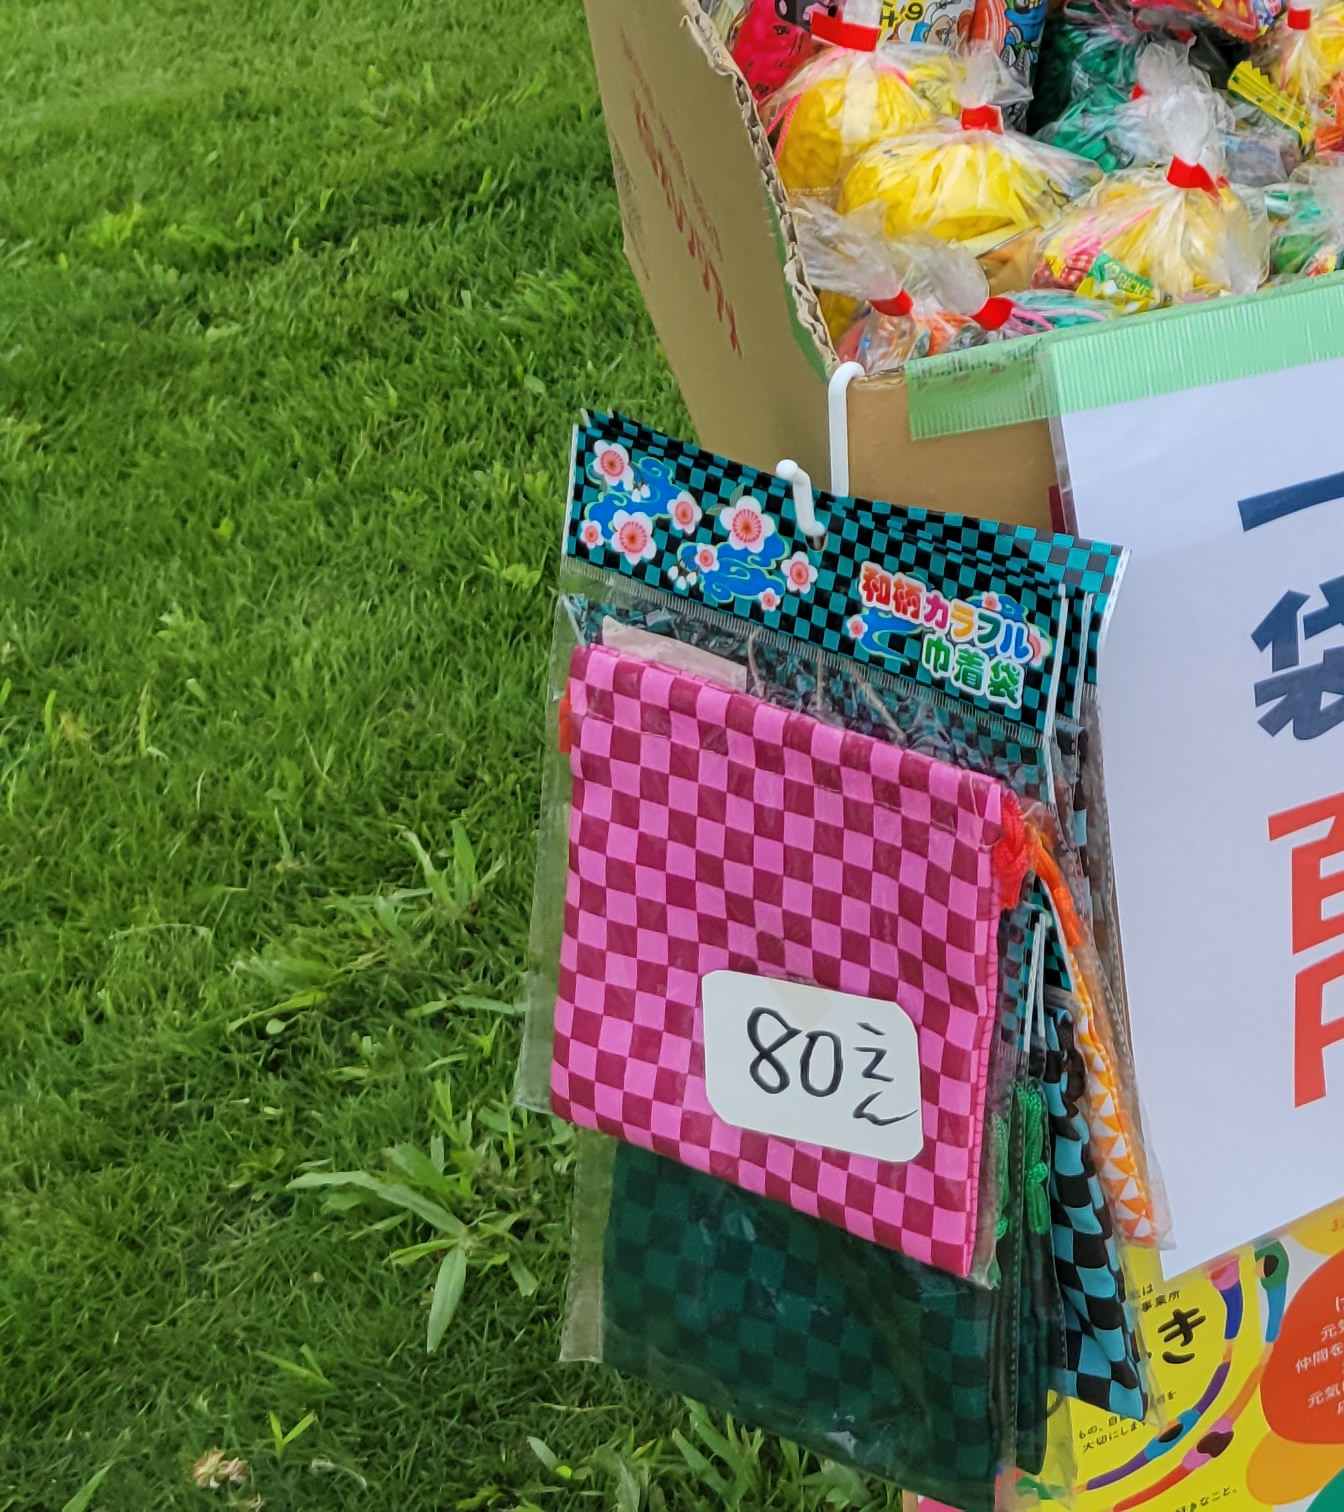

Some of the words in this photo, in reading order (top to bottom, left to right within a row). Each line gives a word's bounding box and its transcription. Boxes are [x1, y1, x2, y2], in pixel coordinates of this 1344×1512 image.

[859, 563, 1035, 663] 和柄カラフル
[921, 635, 1024, 708] 巾着袋
[746, 1006, 919, 1127] 80えん
